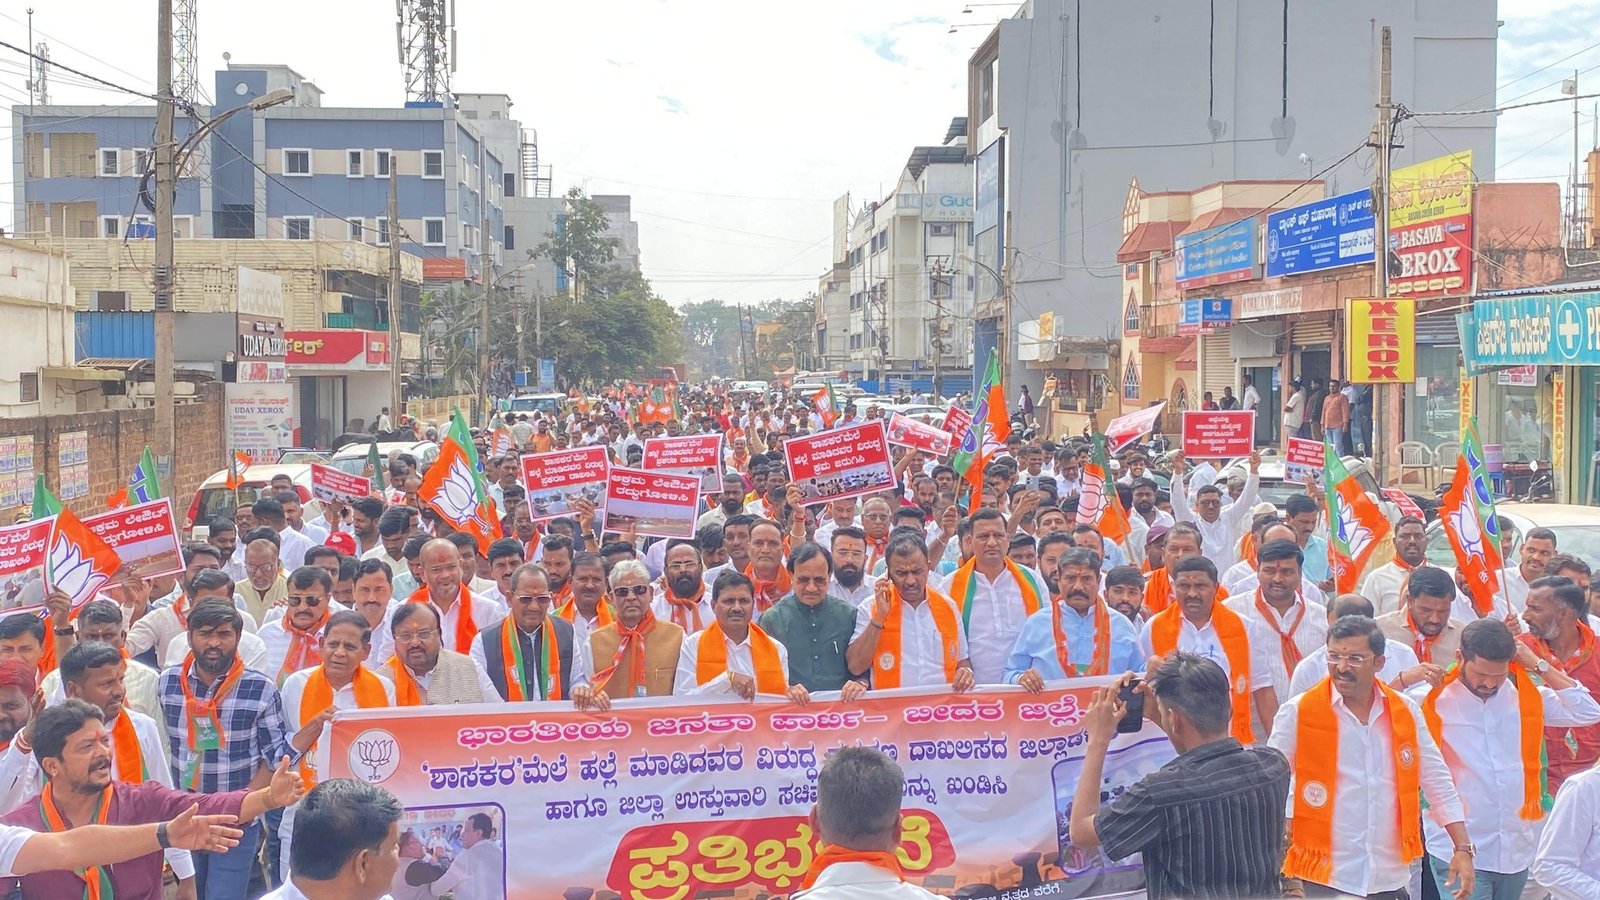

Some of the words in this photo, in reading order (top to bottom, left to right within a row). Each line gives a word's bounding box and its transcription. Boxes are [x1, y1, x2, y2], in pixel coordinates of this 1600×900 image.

[1401, 225, 1445, 249] BASAVA
[1231, 252, 1249, 263] India
[1392, 246, 1462, 279] EROX
[243, 334, 263, 357] UDAY
[1368, 302, 1399, 379] XEROX
[261, 448, 279, 457] XER
[811, 445, 853, 460] ಮಾಡಿದವರ
[101, 523, 165, 547] ದ್ದುಗೋಳಿಸಿ
[459, 718, 630, 748] ಭಾರತೀಯ
[650, 712, 755, 736] ಜನತಾ
[905, 699, 1003, 723] ಬೀದರ
[580, 751, 618, 789] ಹಲ್ಲೆ
[630, 743, 744, 778] ಮಾಡಿದವರ
[909, 731, 1008, 762] ದಾಖಲಿಸದ
[545, 793, 608, 821] ಹಾಗೂ
[619, 793, 665, 822] ಜಿಲ್ಲಾ
[675, 784, 767, 818] ಉಸ್ತುವಾರಿ
[947, 774, 1008, 796] ಖಂಡಿಸಿ
